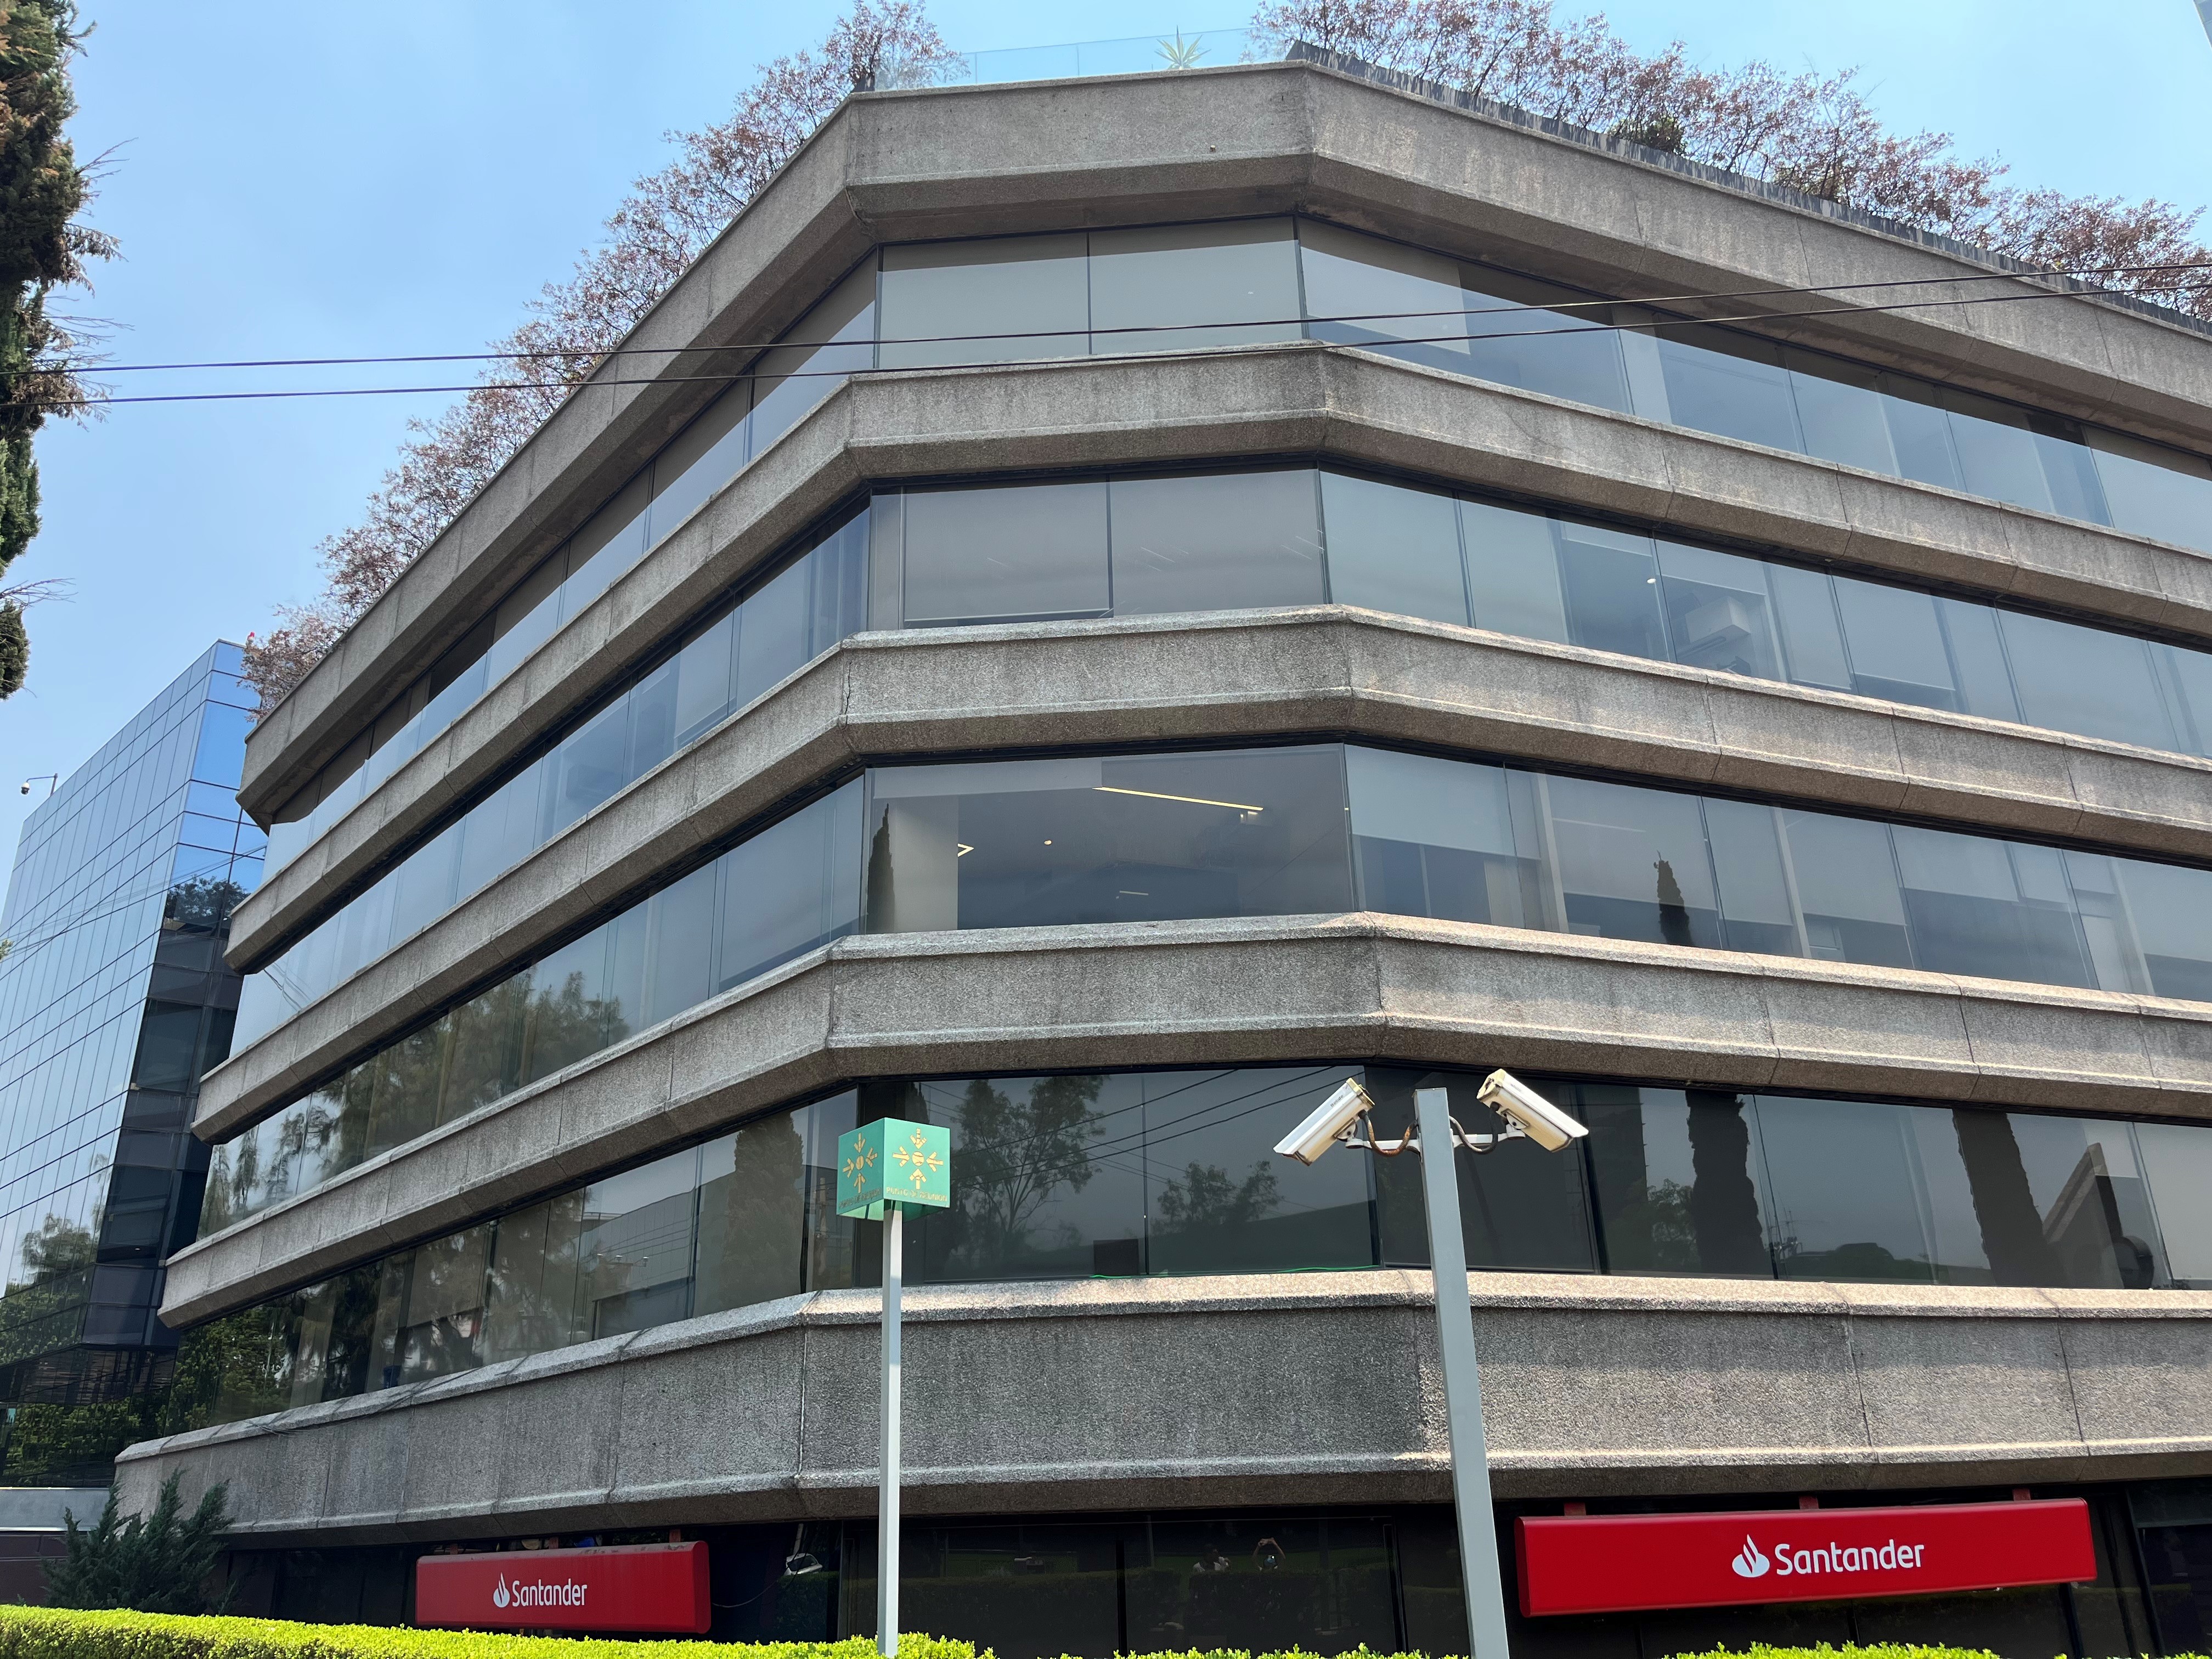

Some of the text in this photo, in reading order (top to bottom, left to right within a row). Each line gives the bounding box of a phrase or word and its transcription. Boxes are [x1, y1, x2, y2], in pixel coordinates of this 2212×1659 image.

[886, 1187, 909, 1197] PUNTO
[1775, 1539, 1925, 1576] Santander
[512, 1578, 588, 1607] Santander
